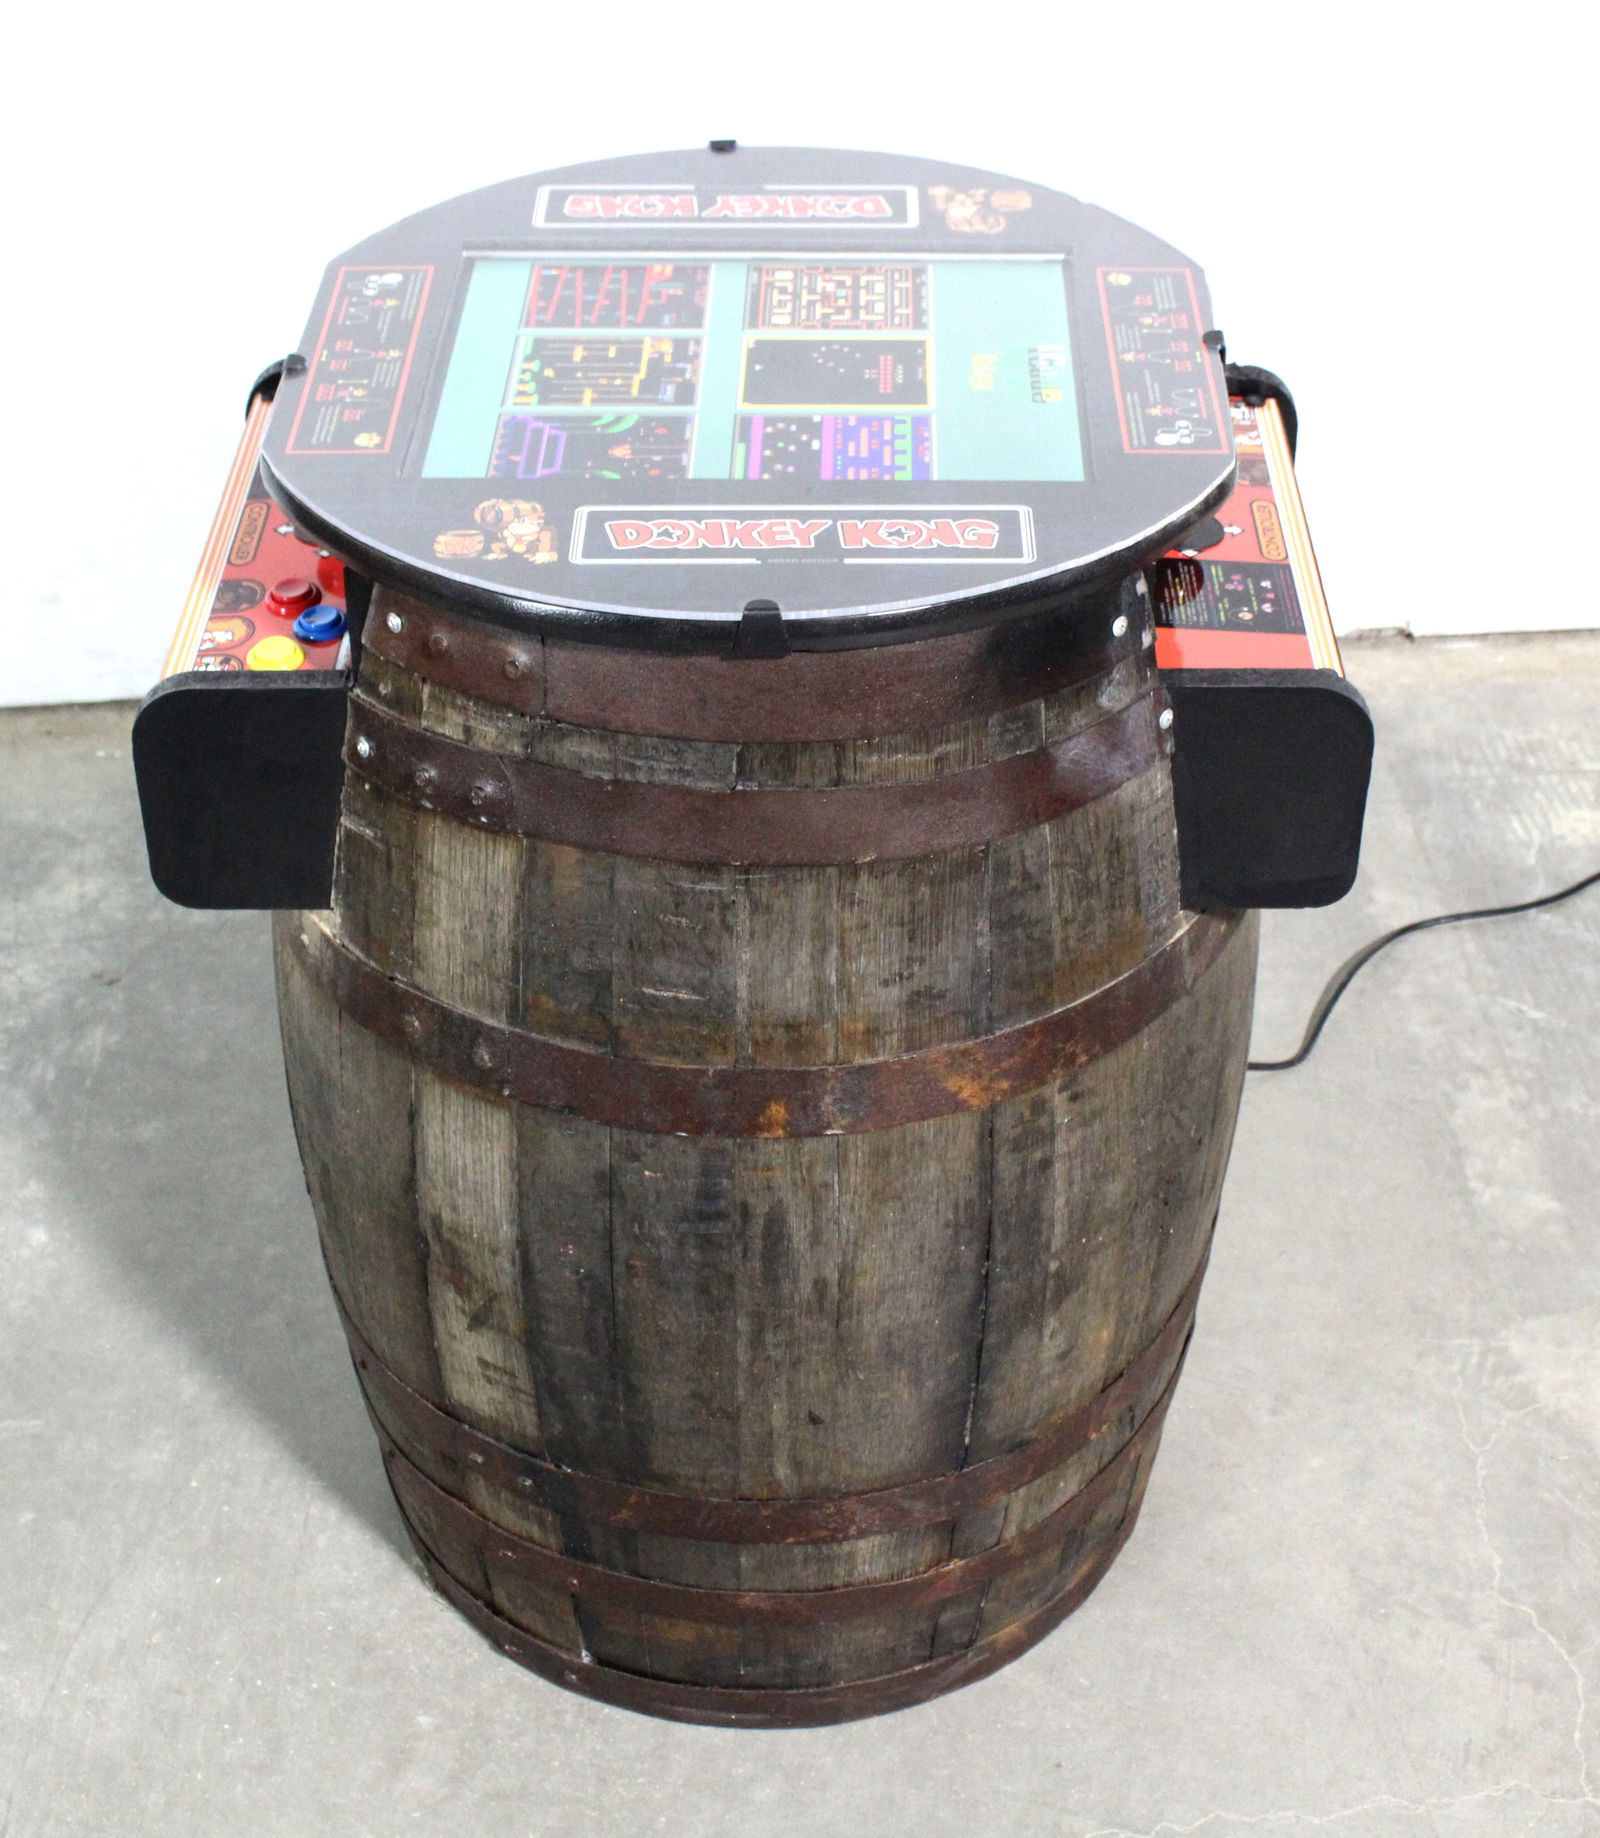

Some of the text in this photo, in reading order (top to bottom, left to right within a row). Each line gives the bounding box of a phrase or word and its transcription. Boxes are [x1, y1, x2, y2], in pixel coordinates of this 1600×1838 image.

[562, 194, 893, 217] DONKEY KONG
[604, 518, 1000, 550] DONKEY KONG
